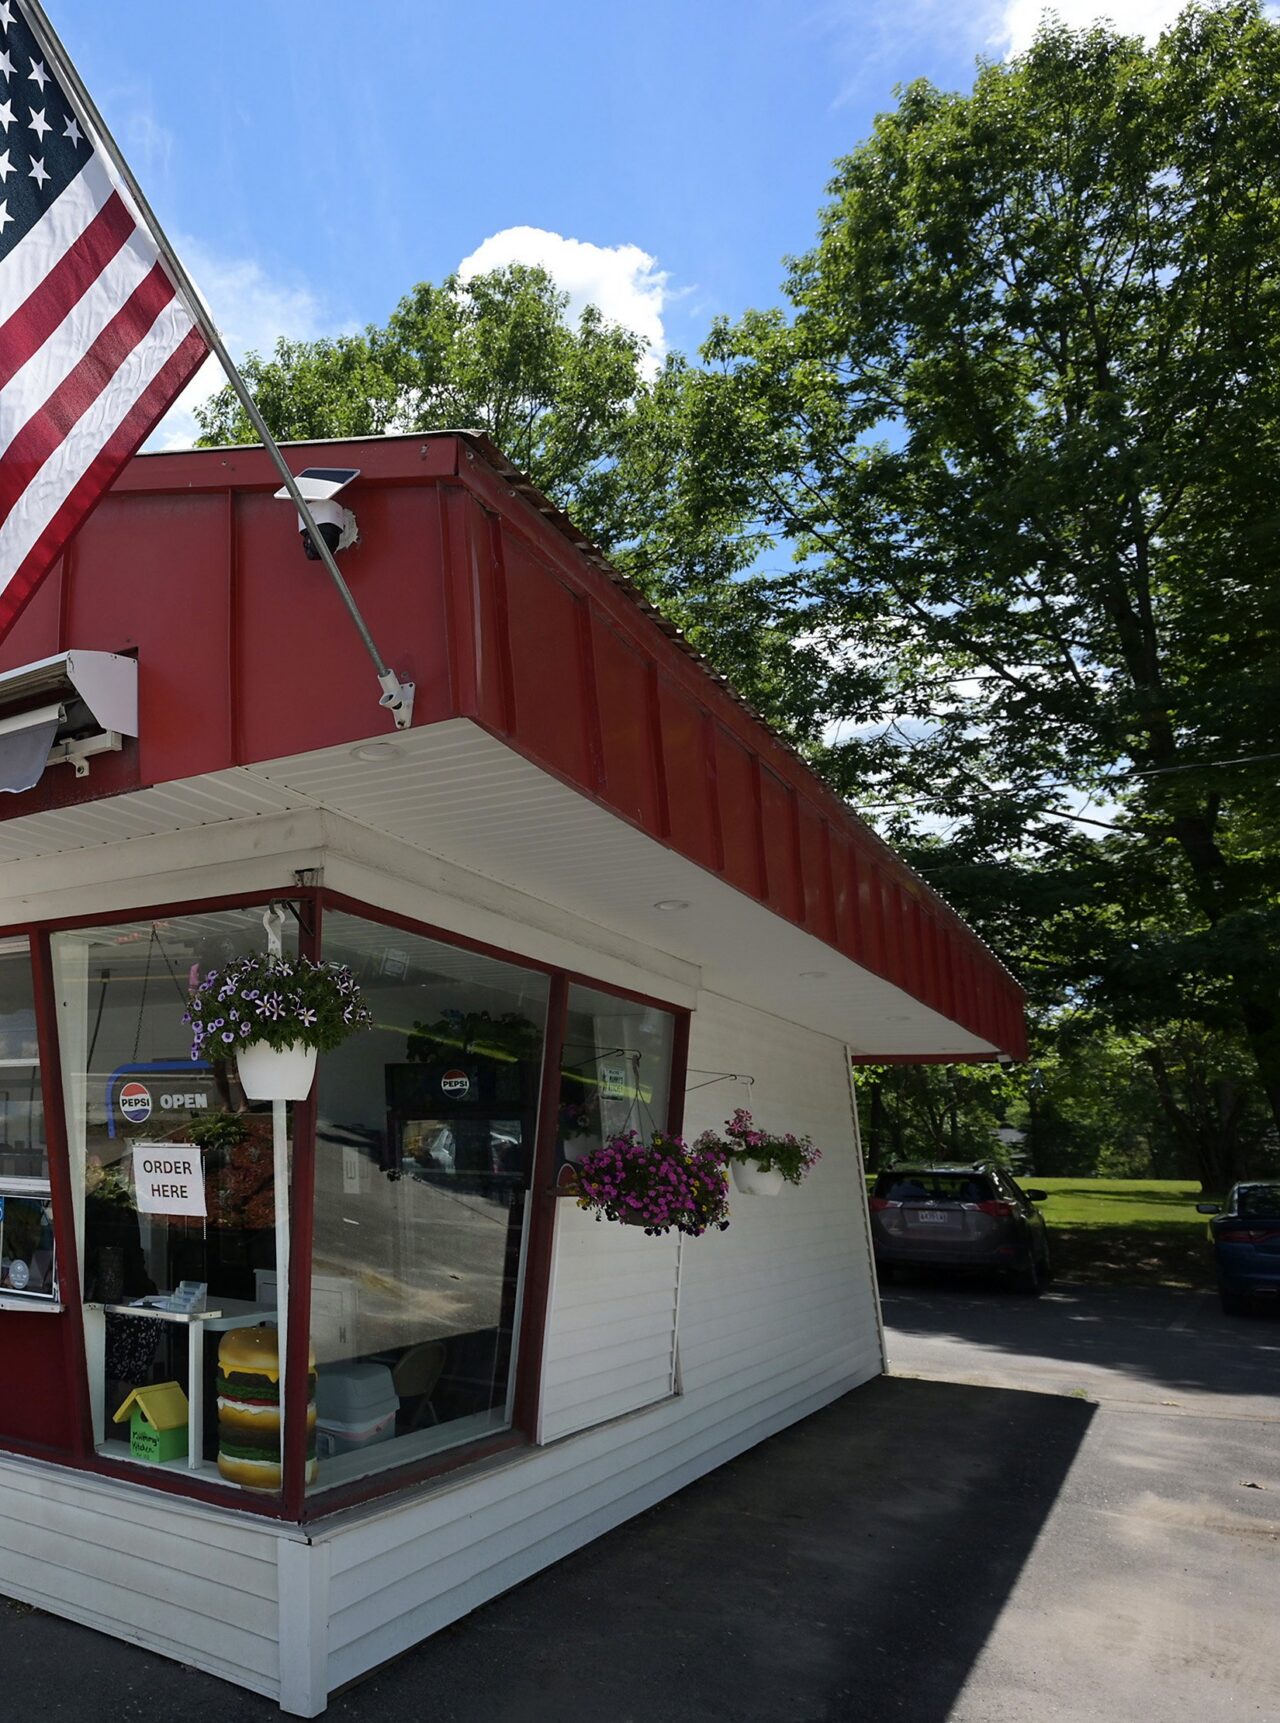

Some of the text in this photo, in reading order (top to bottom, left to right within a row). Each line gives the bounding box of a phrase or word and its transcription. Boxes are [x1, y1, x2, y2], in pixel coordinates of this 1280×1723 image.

[443, 1080, 468, 1088] PEPSI
[122, 1098, 150, 1108] PEPSI
[160, 1093, 208, 1109] OPEN
[143, 1159, 193, 1175] ORDER
[151, 1183, 188, 1199] HERE
